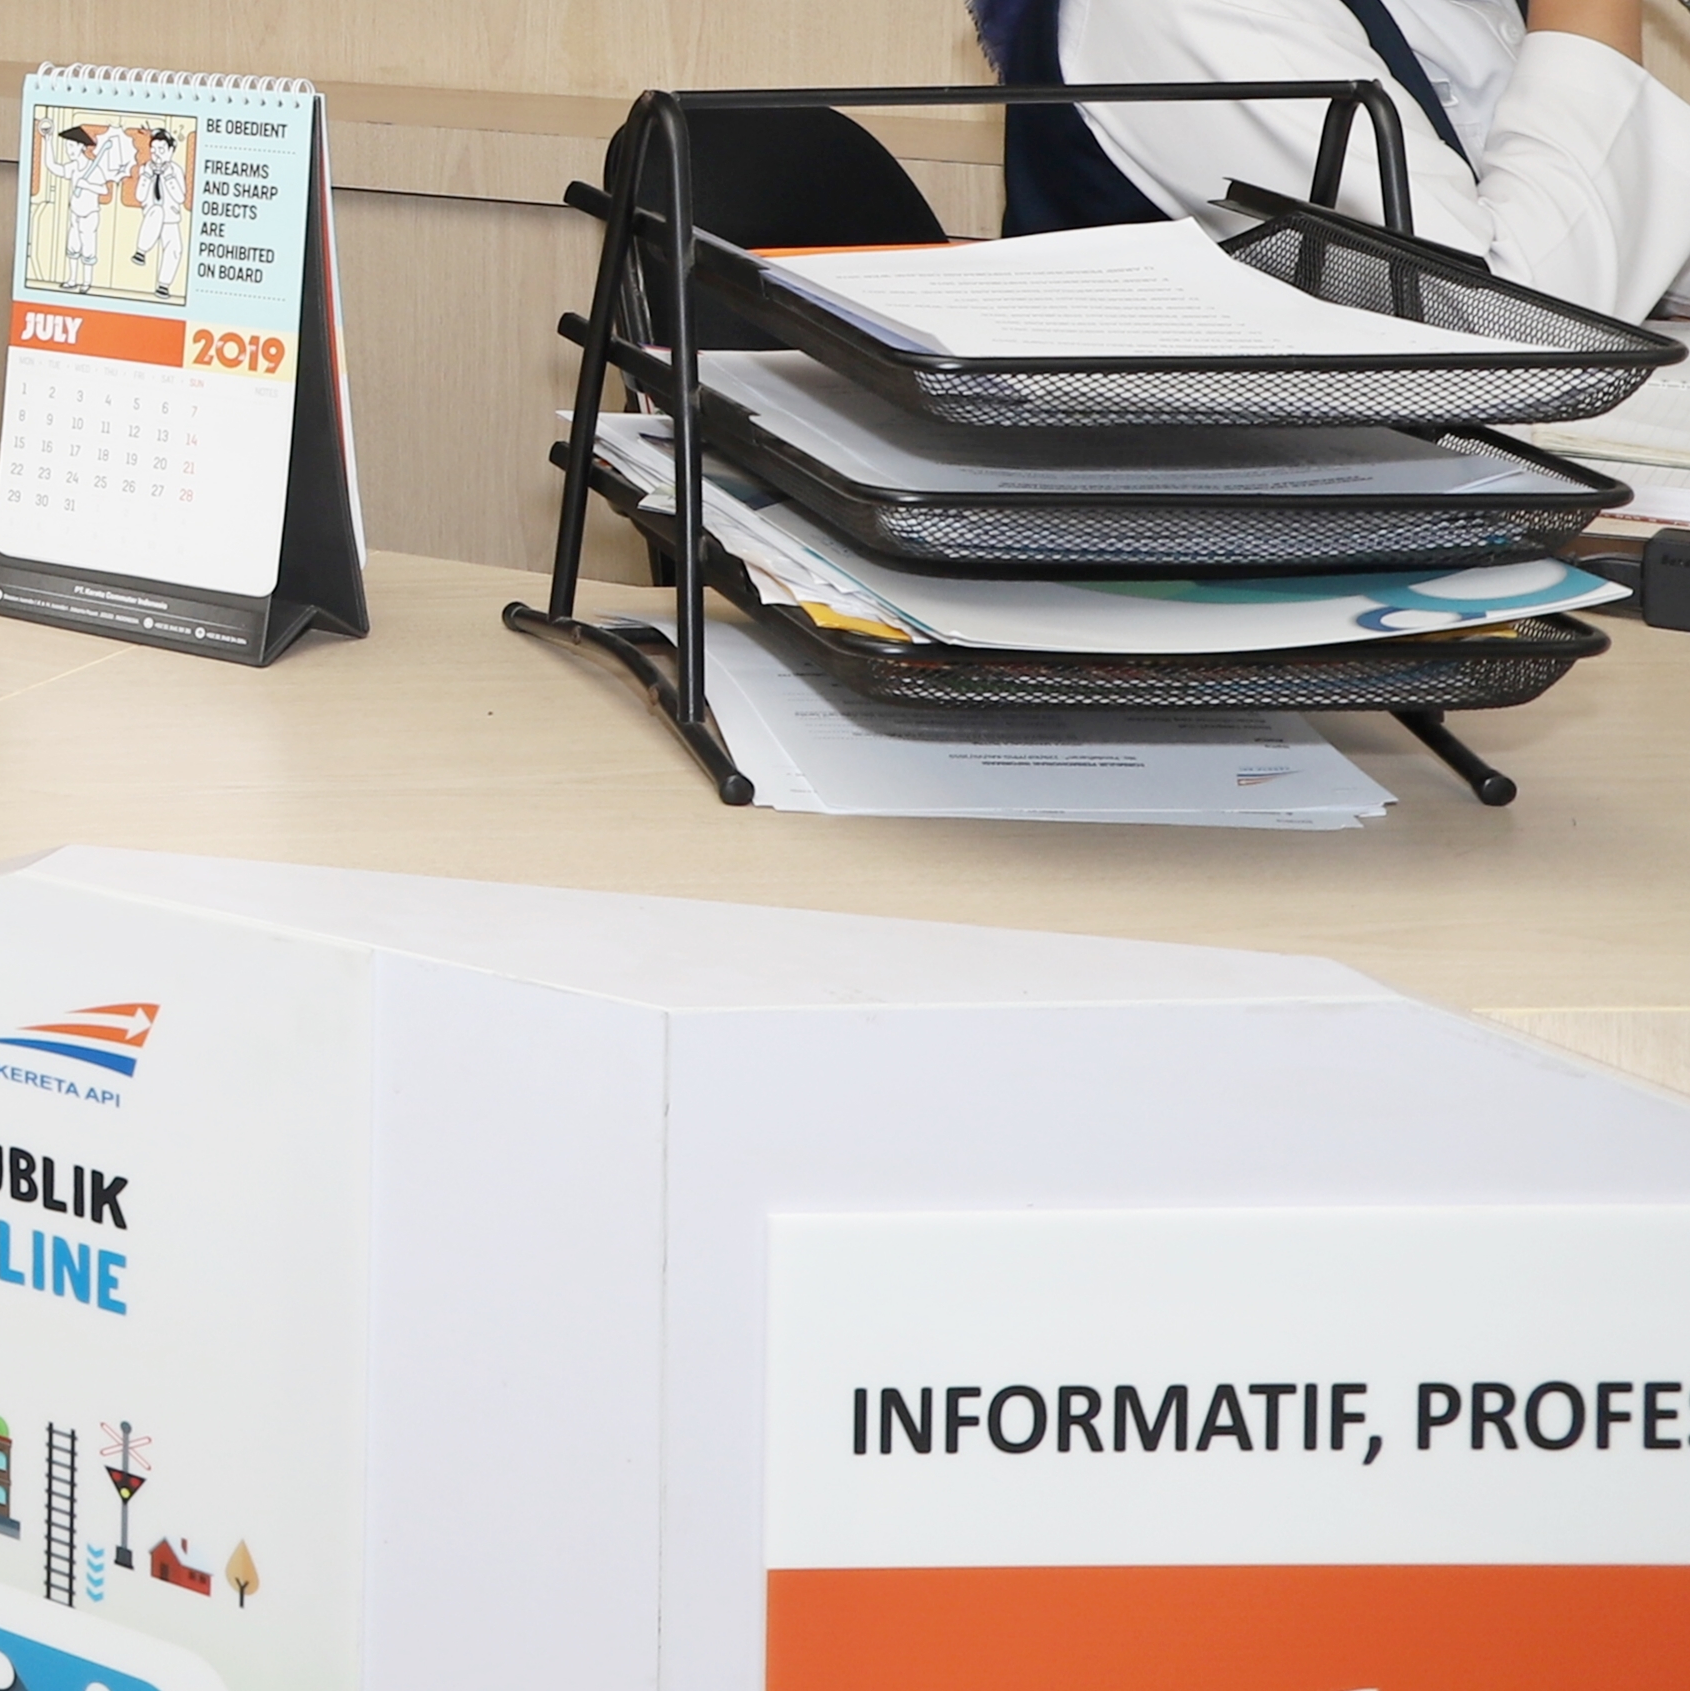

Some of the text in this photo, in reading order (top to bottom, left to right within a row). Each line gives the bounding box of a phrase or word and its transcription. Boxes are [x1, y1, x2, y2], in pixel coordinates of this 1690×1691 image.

[206, 118, 288, 139] BE OBEDIENT
[204, 159, 270, 179] FIREARMS
[202, 180, 278, 201] AND SHARP
[201, 200, 258, 220] OBJECTS
[200, 221, 226, 238] ARE
[199, 242, 275, 264] PROHIBITED
[197, 262, 263, 283] ON BOARD
[20, 311, 286, 374] JULY 2019
[133, 370, 145, 381] FRI
[161, 374, 175, 384] SAT
[189, 378, 205, 388] SUN
[22, 382, 198, 417] 1 2 3 4 5 6 7
[19, 410, 197, 446] 8 9 10 11 12 13 14
[14, 436, 195, 474] 15 16 17 18 19 20 21
[10, 462, 194, 502] 22 23 24 25 26 27 28
[8, 490, 75, 511] 29 30 31
[85, 1084, 120, 1109] API
[851, 1381, 1690, 1466] INFORMATIF, PROFE
